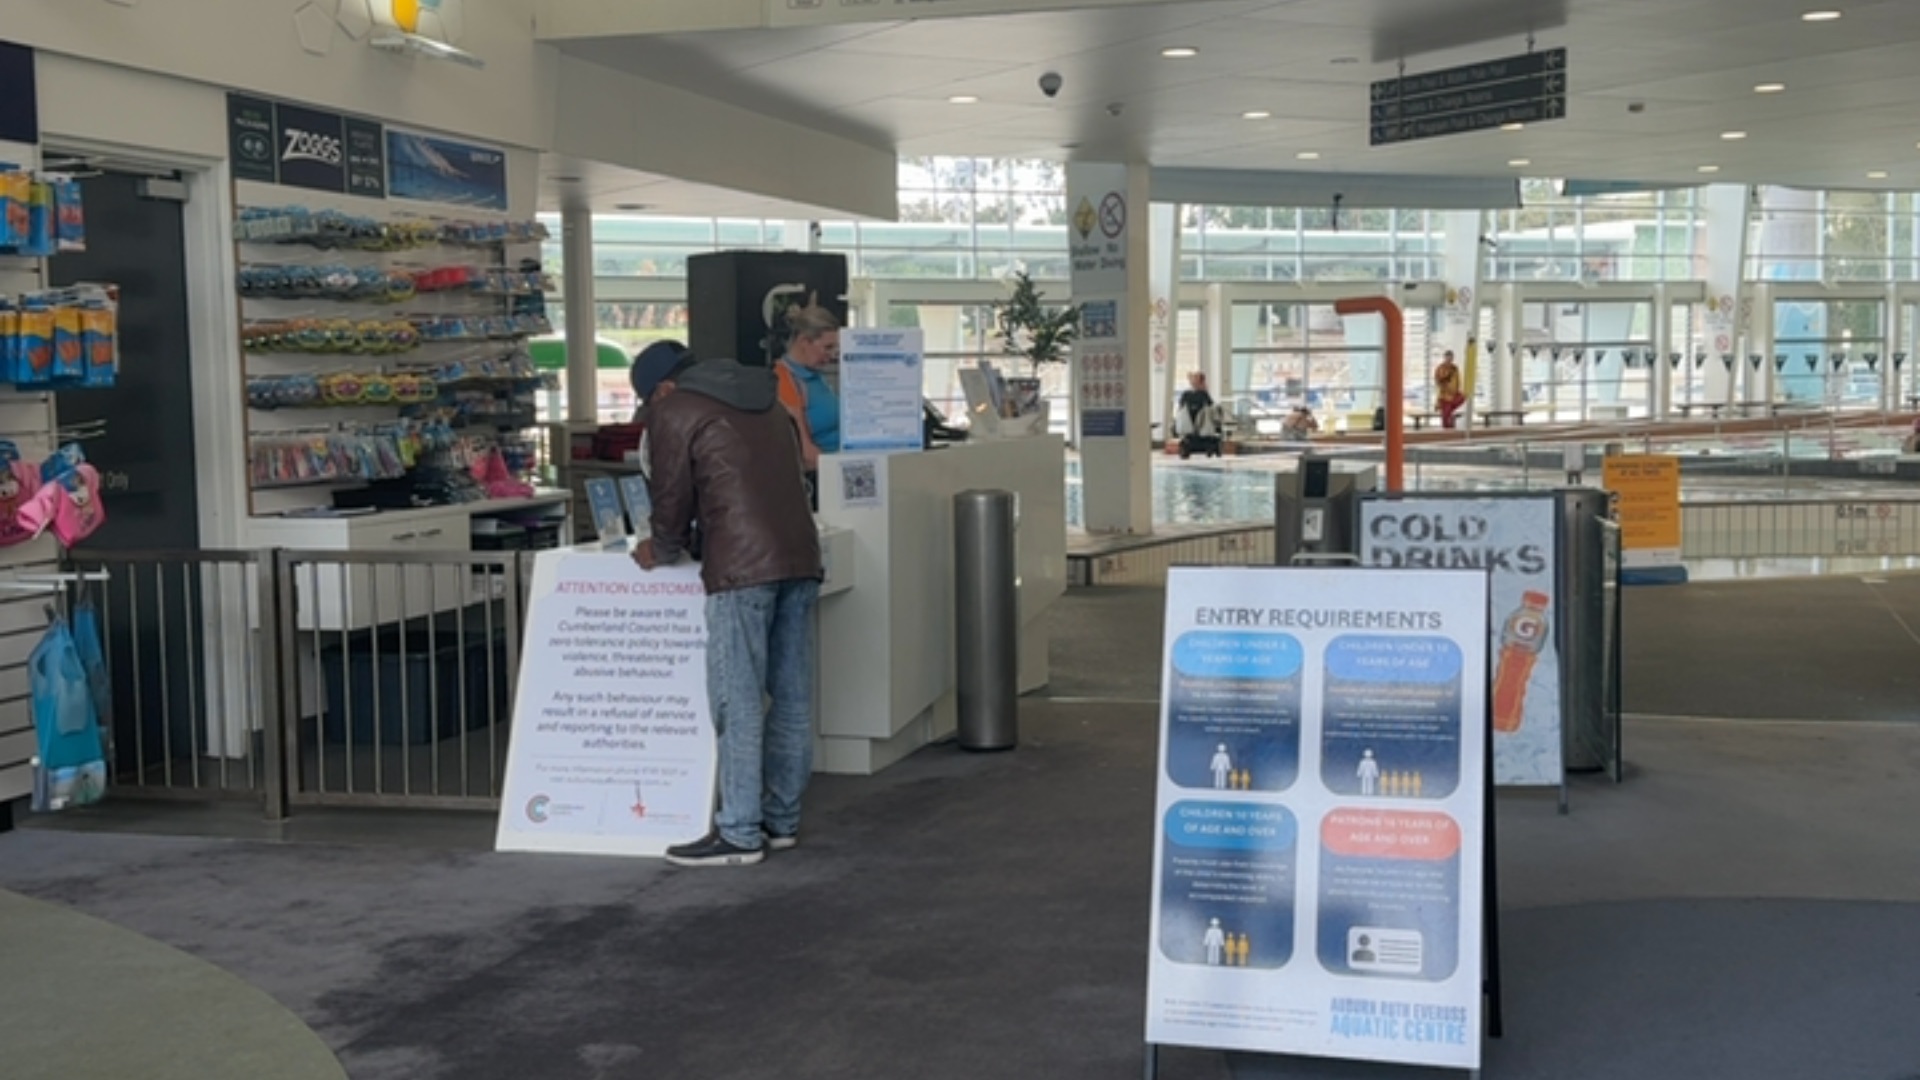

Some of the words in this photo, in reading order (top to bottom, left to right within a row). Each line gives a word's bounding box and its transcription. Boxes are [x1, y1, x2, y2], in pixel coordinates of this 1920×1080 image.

[282, 128, 343, 165] ZOGGS
[1370, 513, 1488, 542] COLD
[1372, 544, 1547, 575] DRINKS
[555, 582, 628, 595] ATTENTION
[575, 606, 610, 618] Please
[613, 606, 626, 618] be
[630, 609, 661, 618] aware
[664, 607, 688, 618] that
[1195, 607, 1265, 625] ENTRY
[1268, 608, 1443, 630] REQUIREMENTS
[557, 620, 624, 633] Cumberland
[629, 622, 669, 634] Council
[672, 622, 691, 634] has
[628, 638, 660, 650] policy
[1338, 640, 1393, 651] CHILDREN
[612, 652, 676, 665] threatening
[678, 655, 691, 663] or
[573, 667, 614, 677] abusive
[551, 691, 573, 704] Any
[576, 691, 603, 703] such
[607, 692, 662, 704] behaviour
[666, 695, 690, 706] may
[541, 706, 574, 717] result
[577, 707, 588, 717] in
[600, 707, 637, 719] refusal
[640, 708, 652, 719] of
[655, 710, 697, 721] service
[536, 721, 558, 732] and
[560, 722, 614, 736] reporting
[615, 723, 628, 733] to
[631, 724, 649, 734] the
[652, 725, 699, 736] relevant
[1178, 807, 1233, 819] CHILDREN
[1249, 811, 1284, 822] YEARS
[1329, 815, 1382, 826] PATRONS
[1183, 822, 1199, 834] OF
[1200, 823, 1221, 835] AGE
[1223, 824, 1246, 836] AND
[1247, 825, 1276, 837] OVER
[1349, 832, 1372, 843] AGE
[1374, 833, 1398, 844] AND
[1399, 834, 1431, 845] OVER
[1330, 997, 1377, 1016] AUBURN
[1381, 1000, 1411, 1019] RUTH
[1330, 1013, 1400, 1040] AQUATIC
[1404, 1018, 1466, 1045] CENTRE
